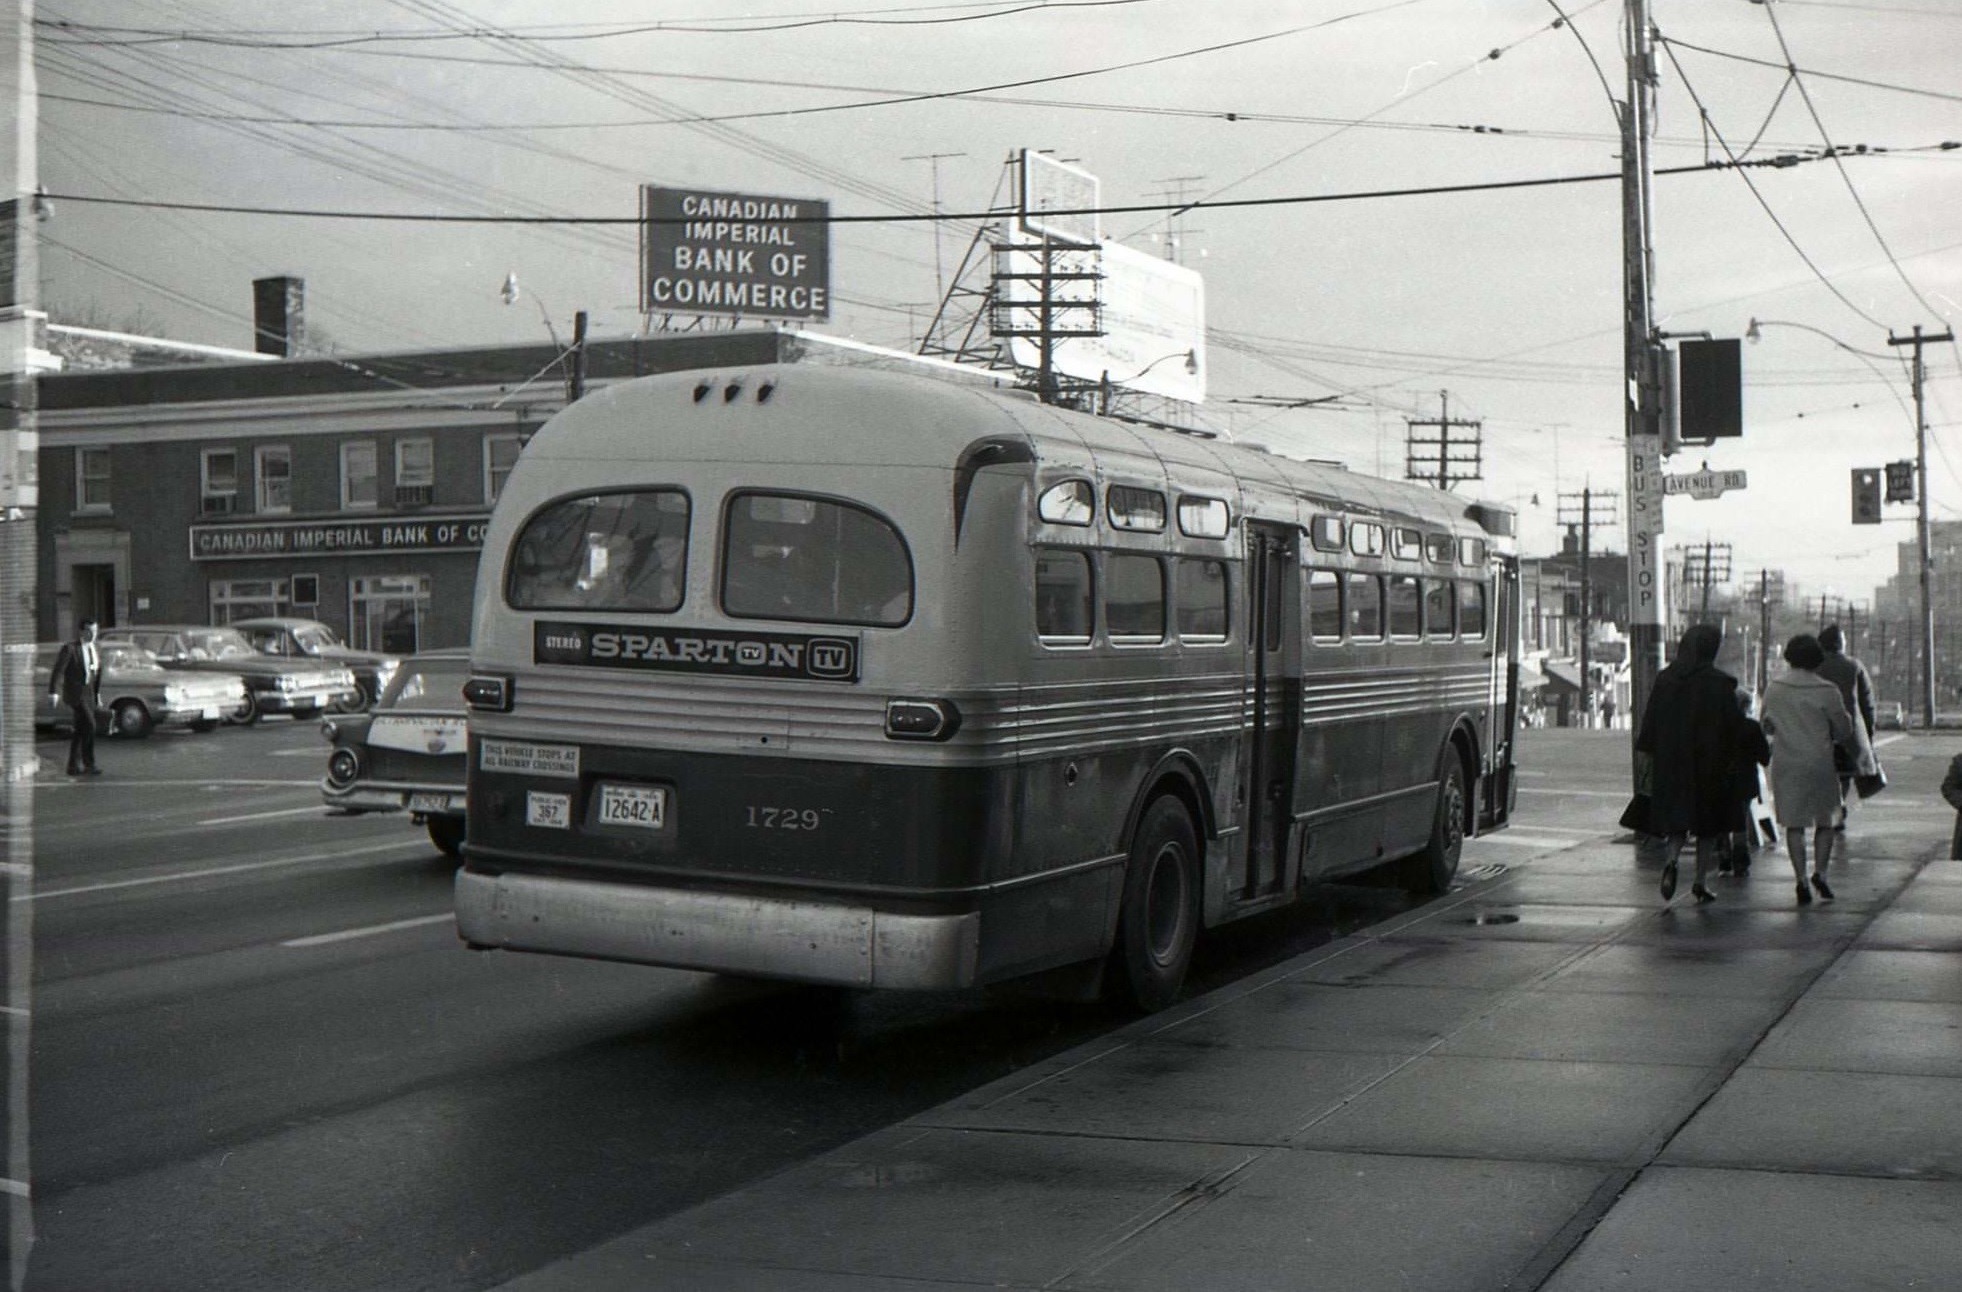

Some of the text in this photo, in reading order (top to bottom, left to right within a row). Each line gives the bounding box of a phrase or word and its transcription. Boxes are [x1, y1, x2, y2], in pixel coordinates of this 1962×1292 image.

[682, 195, 798, 220] CANADIAN
[685, 221, 795, 246] IMPERIAL
[674, 246, 808, 277] BANK OF
[653, 277, 825, 311] COMMERCE
[1669, 474, 1740, 492] AVENUE RD
[200, 532, 285, 551] CANADIAN
[293, 528, 373, 548] IMPERIAL
[382, 526, 428, 544] BANK
[437, 525, 459, 543] OF
[1633, 455, 1651, 606] BUS STOP
[545, 632, 847, 669] STEREO SPARTON TV
[743, 648, 759, 659] TV
[746, 806, 819, 830] 1729
